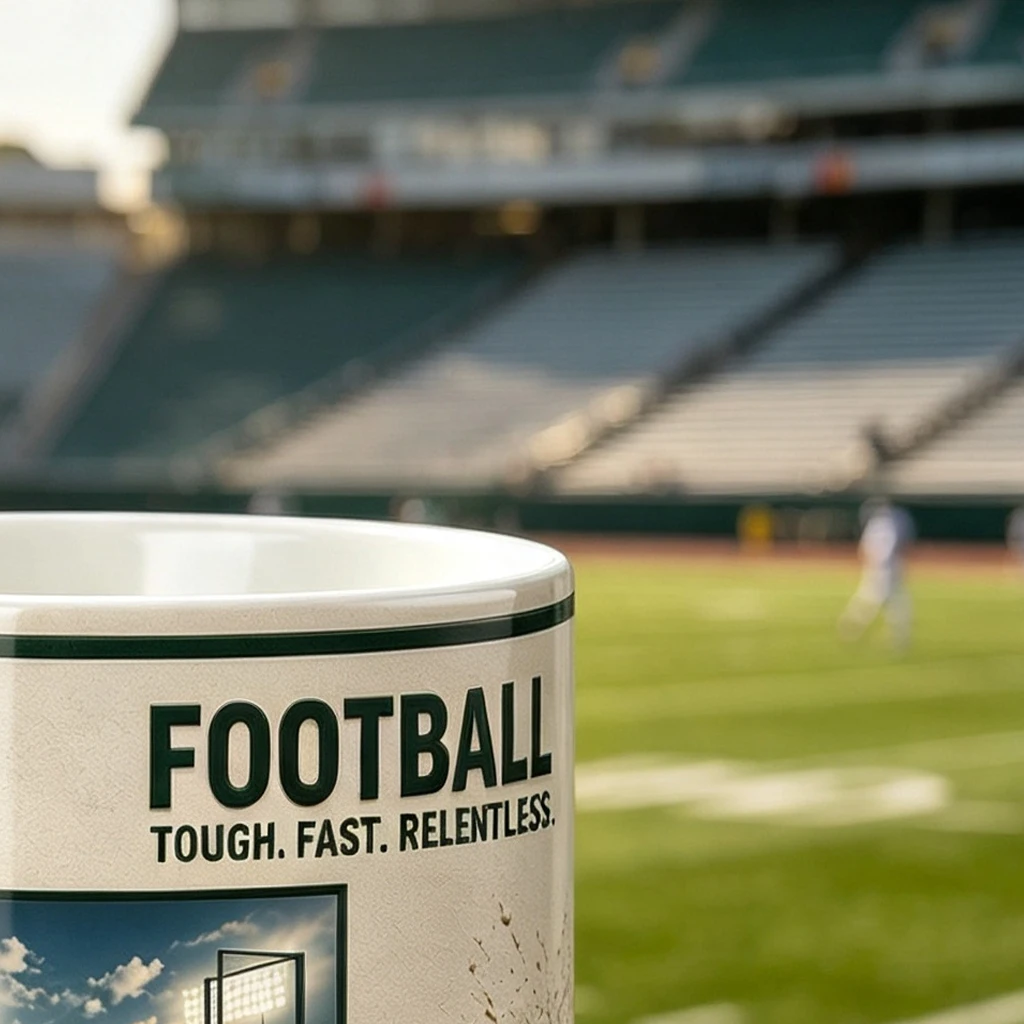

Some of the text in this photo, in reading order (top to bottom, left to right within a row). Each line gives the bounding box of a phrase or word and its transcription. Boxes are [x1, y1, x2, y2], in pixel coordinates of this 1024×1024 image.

[149, 675, 553, 809] FOOTBALL
[149, 790, 556, 863] TOUGH. FAST. RELENTLESS.
